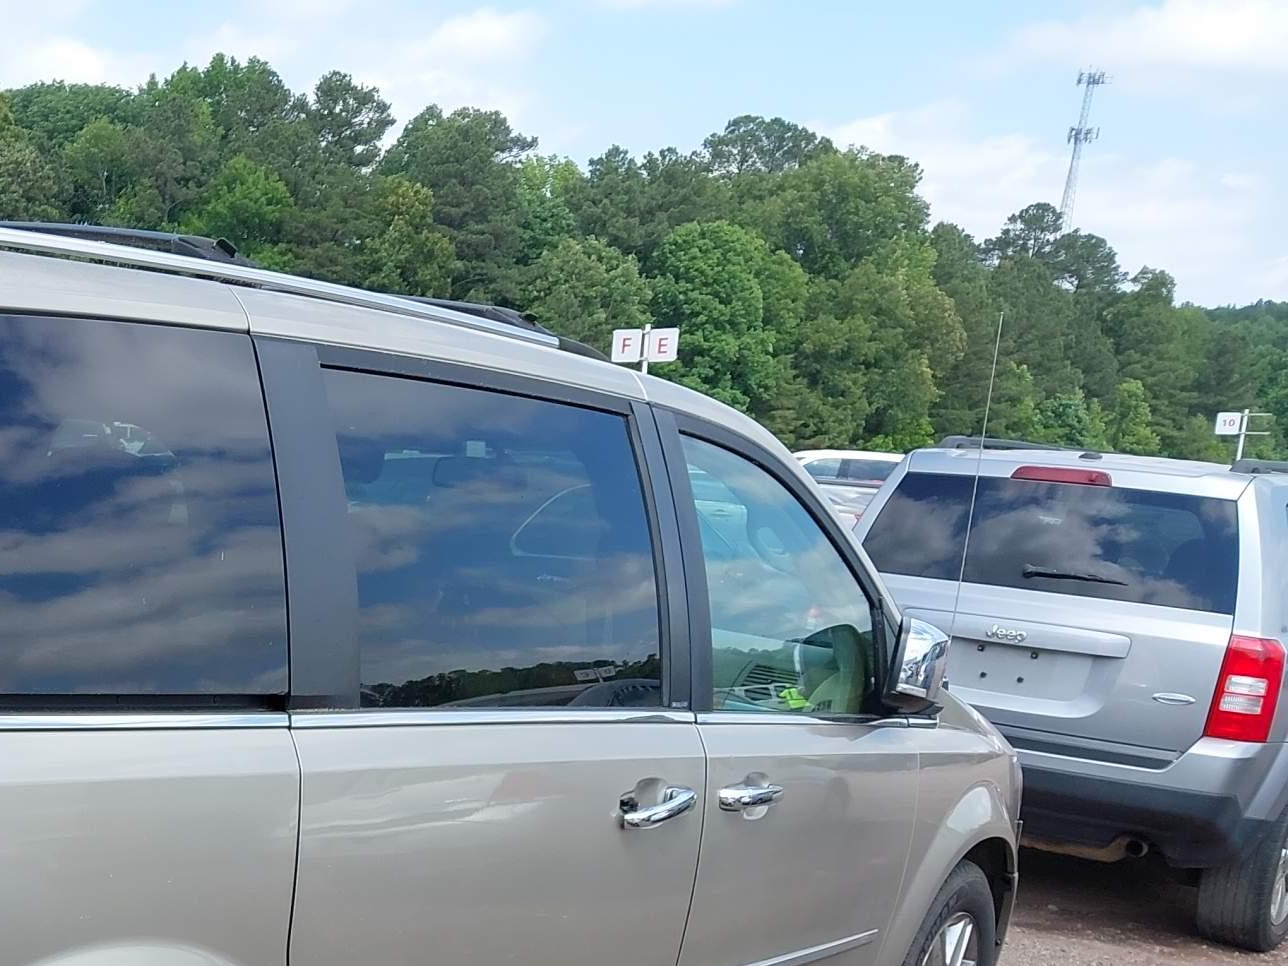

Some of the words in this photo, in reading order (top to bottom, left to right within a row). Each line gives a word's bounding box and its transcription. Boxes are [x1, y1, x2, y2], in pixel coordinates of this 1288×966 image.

[621, 337, 632, 354] F
[657, 337, 669, 354] E
[1223, 419, 1236, 427] 10
[985, 624, 1028, 643] Jeep
